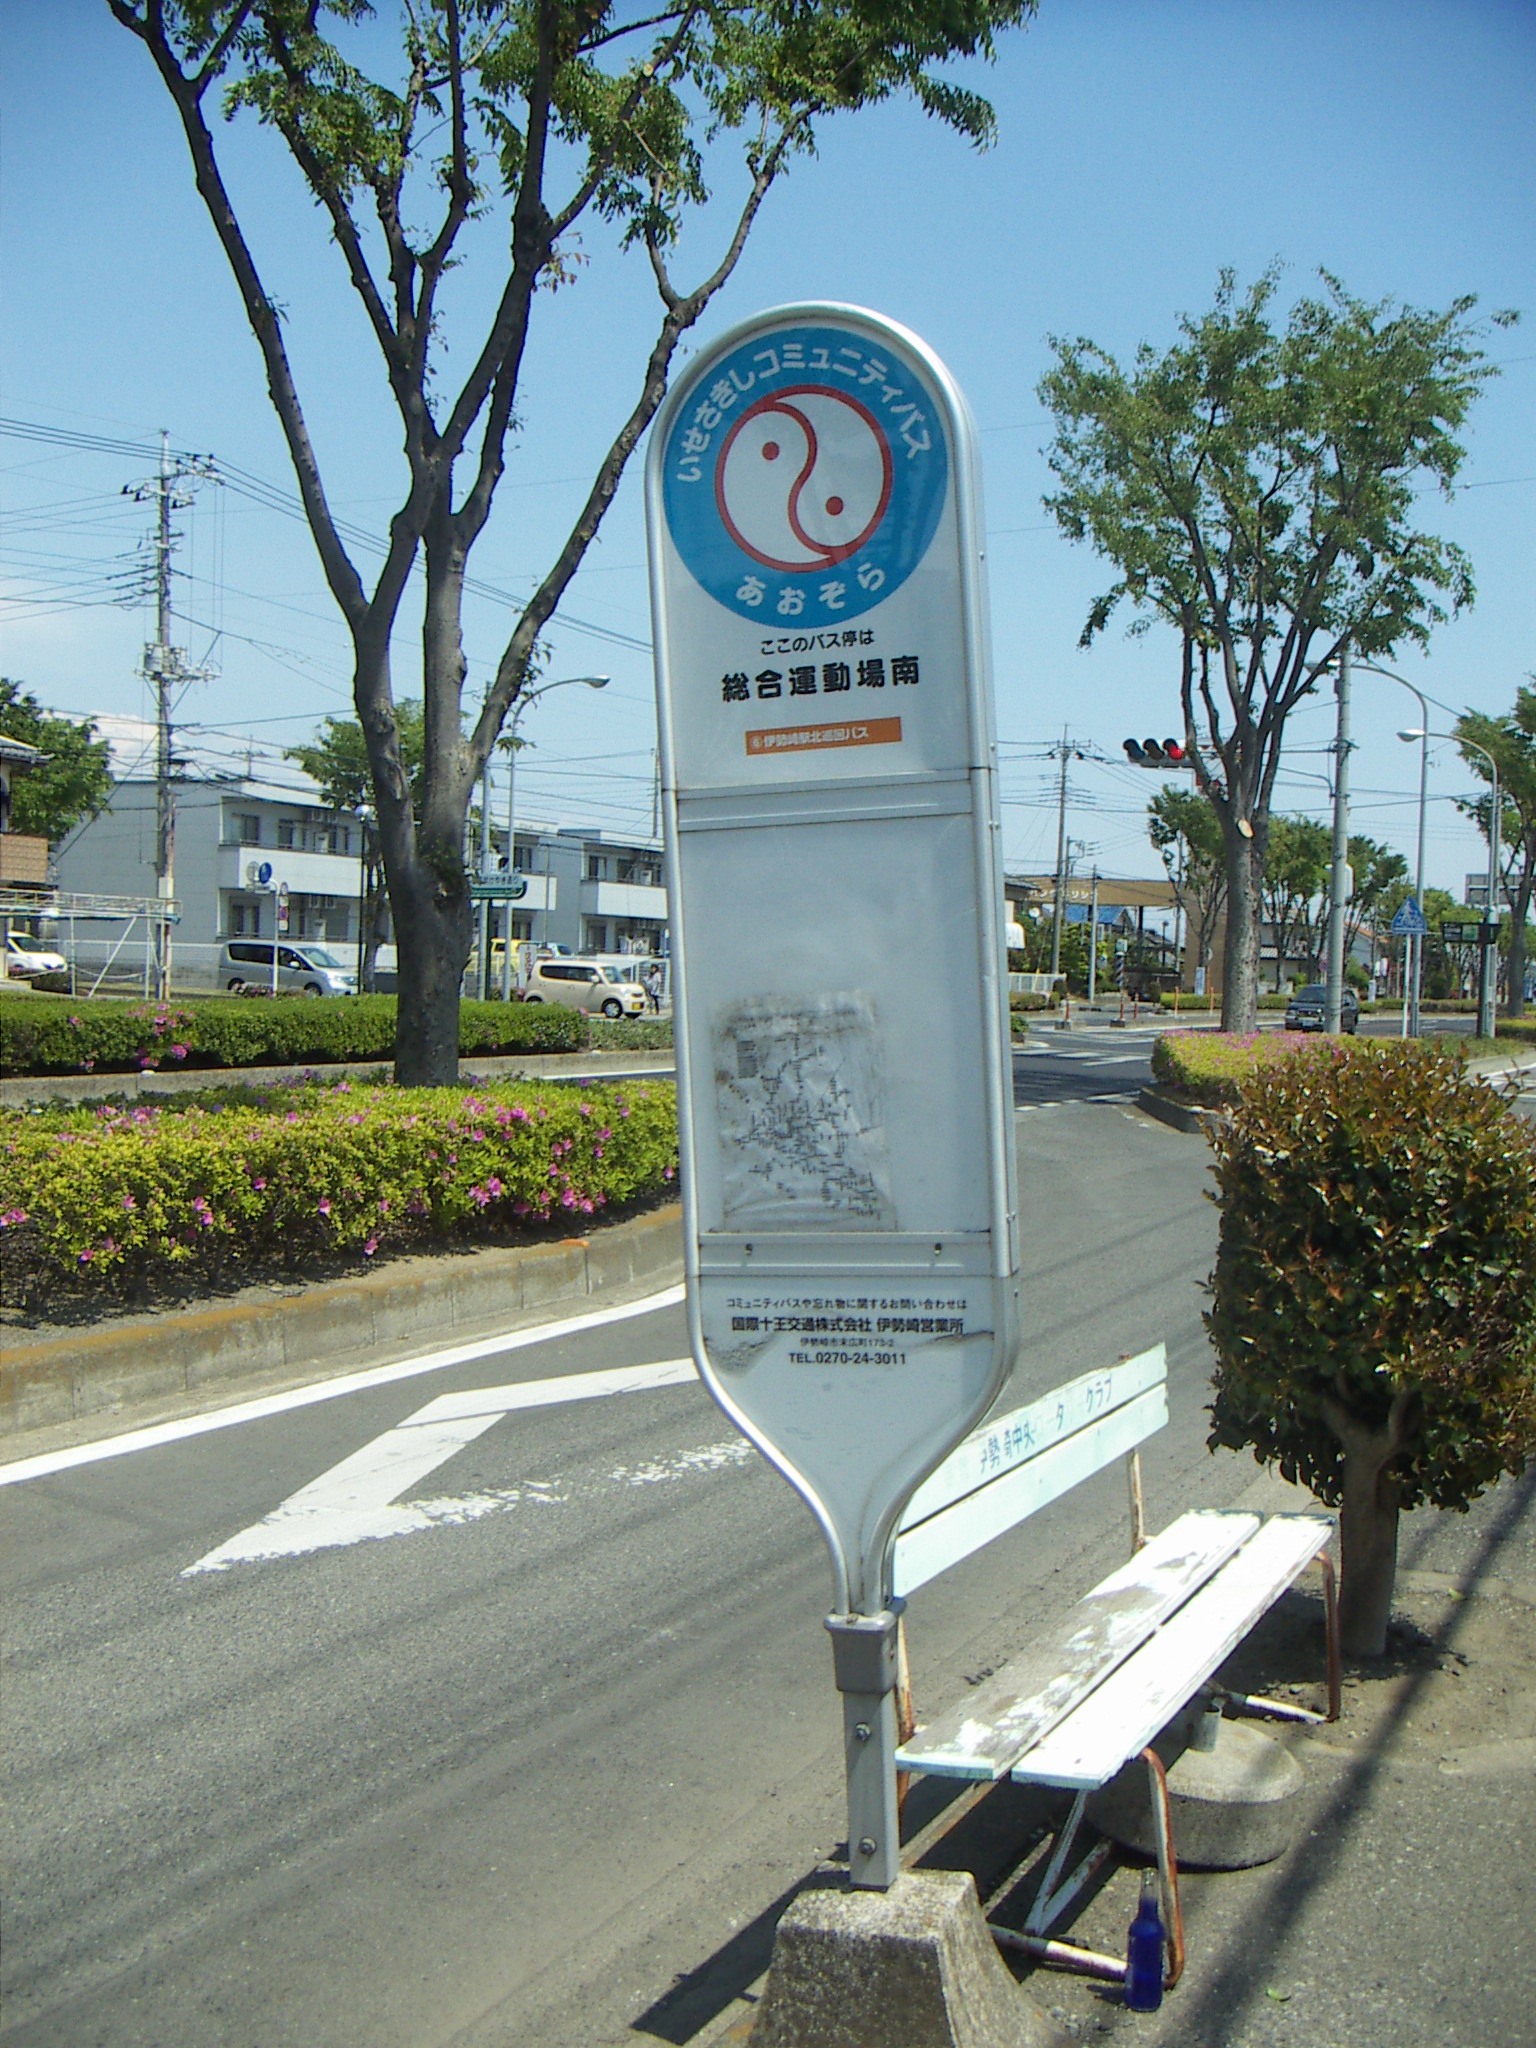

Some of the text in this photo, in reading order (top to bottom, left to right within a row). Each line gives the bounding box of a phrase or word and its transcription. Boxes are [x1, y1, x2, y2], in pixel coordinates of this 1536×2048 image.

[677, 342, 933, 484] いせさきしコミュニティバス
[735, 561, 886, 617] あおぞら
[760, 629, 874, 655] ここのバス停は
[721, 656, 920, 703] 総合運動場南
[731, 1317, 872, 1333] 国際十王交通株式会社
[788, 1352, 907, 1365] TEL.0270-24-3011
